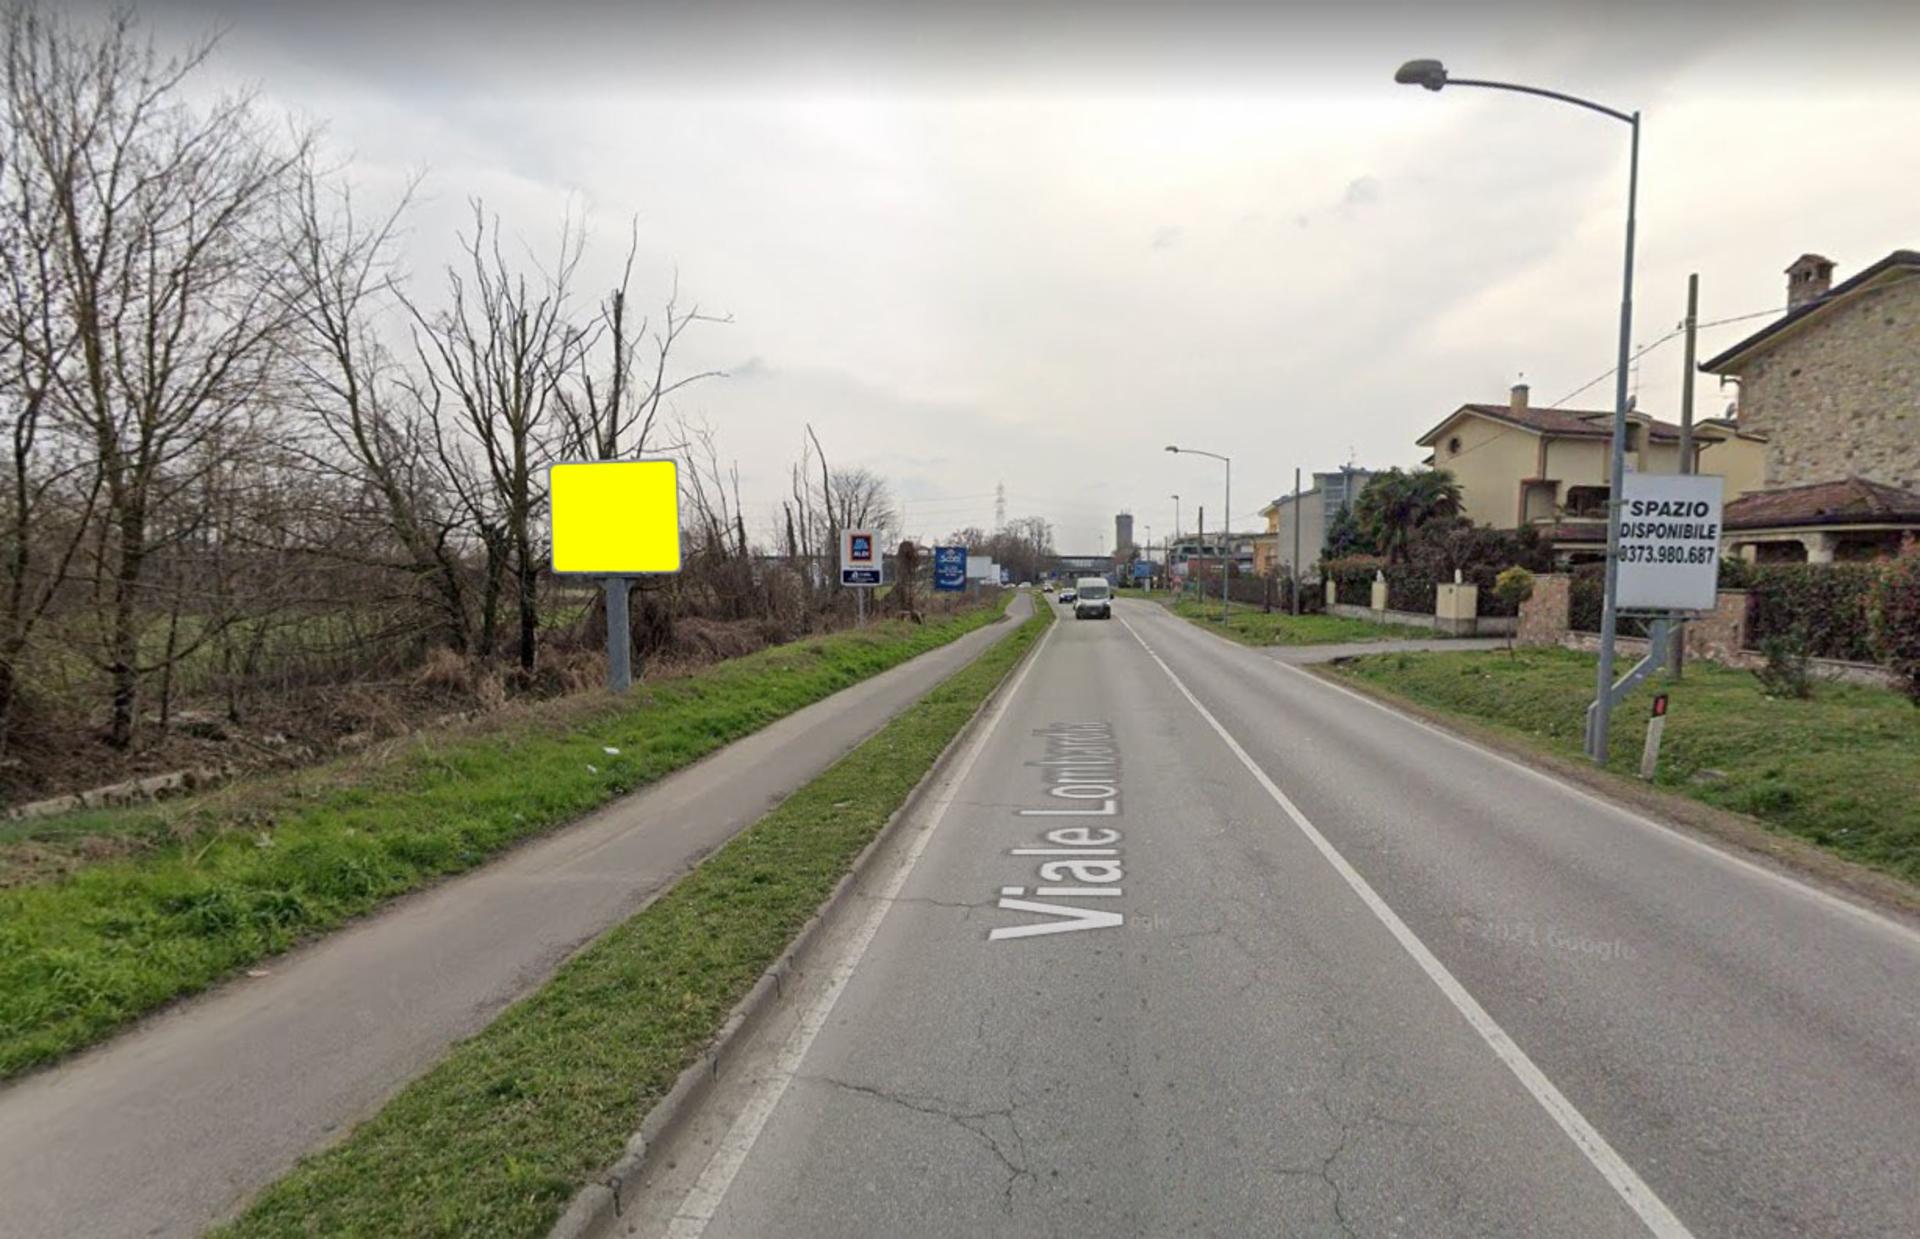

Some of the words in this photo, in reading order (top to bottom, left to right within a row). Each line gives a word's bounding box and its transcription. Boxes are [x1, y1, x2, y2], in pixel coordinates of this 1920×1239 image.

[1630, 501, 1709, 518] SPAZIO
[1620, 523, 1718, 540] DISPONIBILE
[1619, 545, 1715, 564] 0373.980.687
